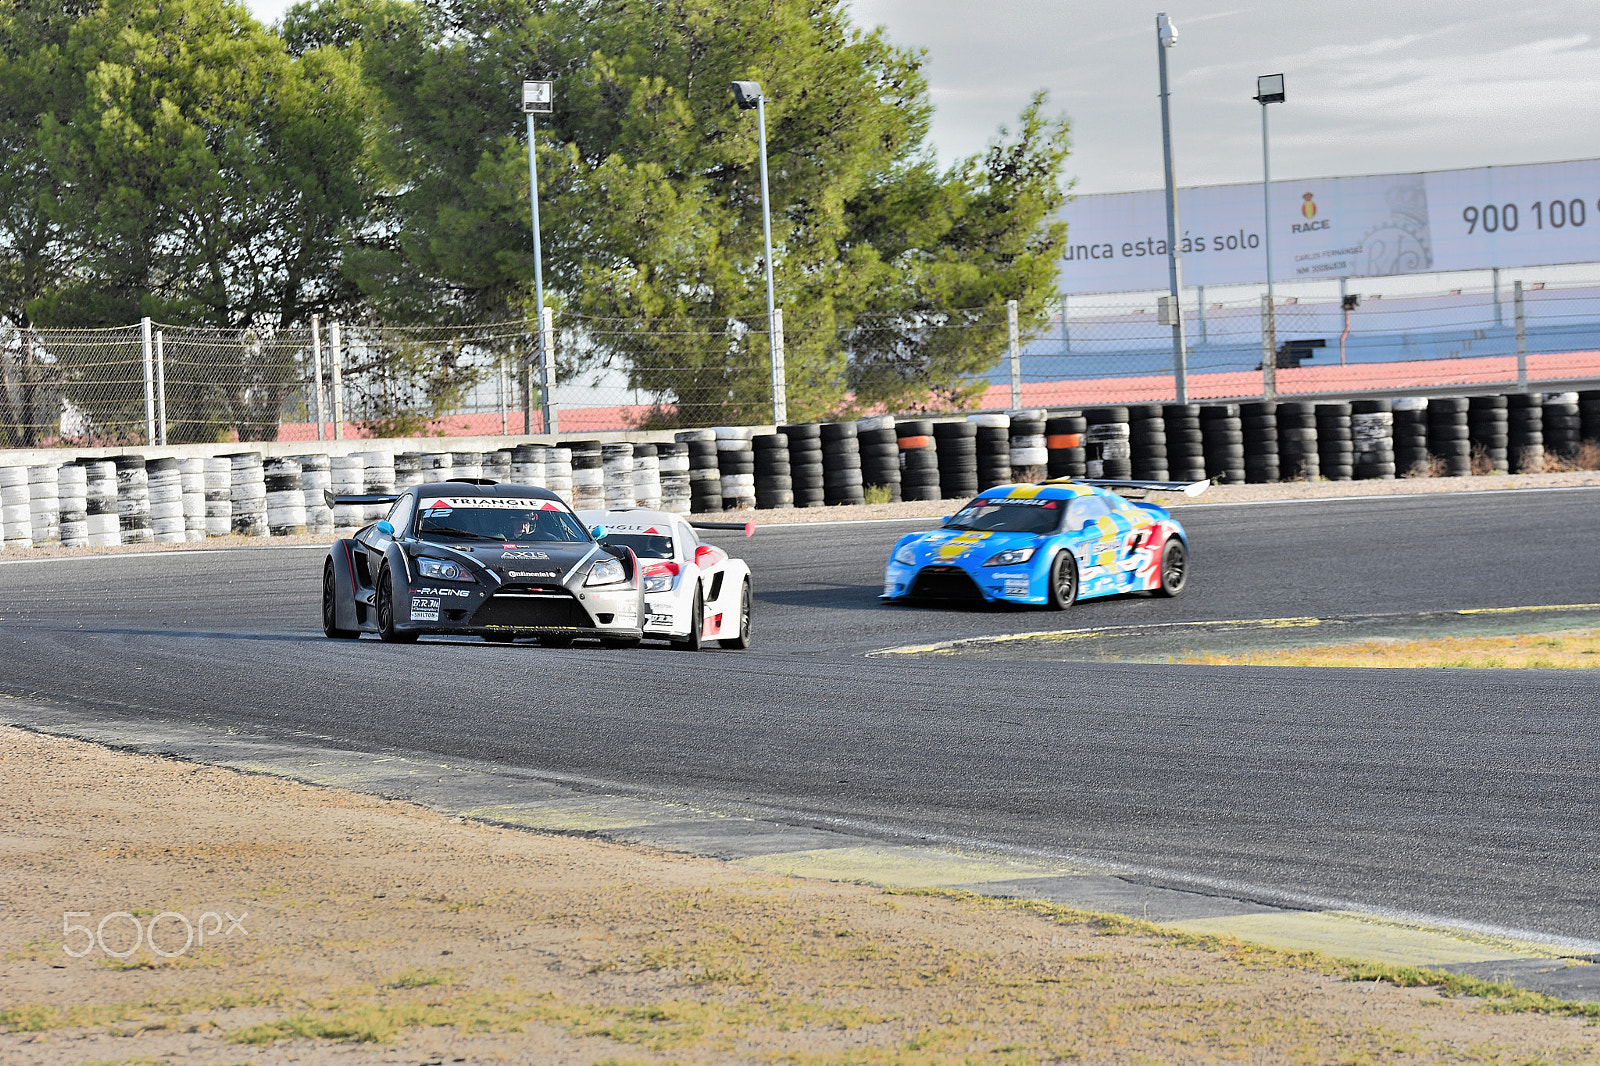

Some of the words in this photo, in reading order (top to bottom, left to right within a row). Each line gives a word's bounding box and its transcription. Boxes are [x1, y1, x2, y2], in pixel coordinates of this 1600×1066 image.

[1463, 203, 1518, 234] 900
[1531, 198, 1586, 230] 100
[1292, 219, 1331, 234] RACE
[1063, 243, 1114, 261] unca
[1121, 231, 1206, 257] estaás
[1213, 229, 1260, 251] solo
[449, 498, 538, 507] TRIANGLE
[423, 508, 453, 519] 12
